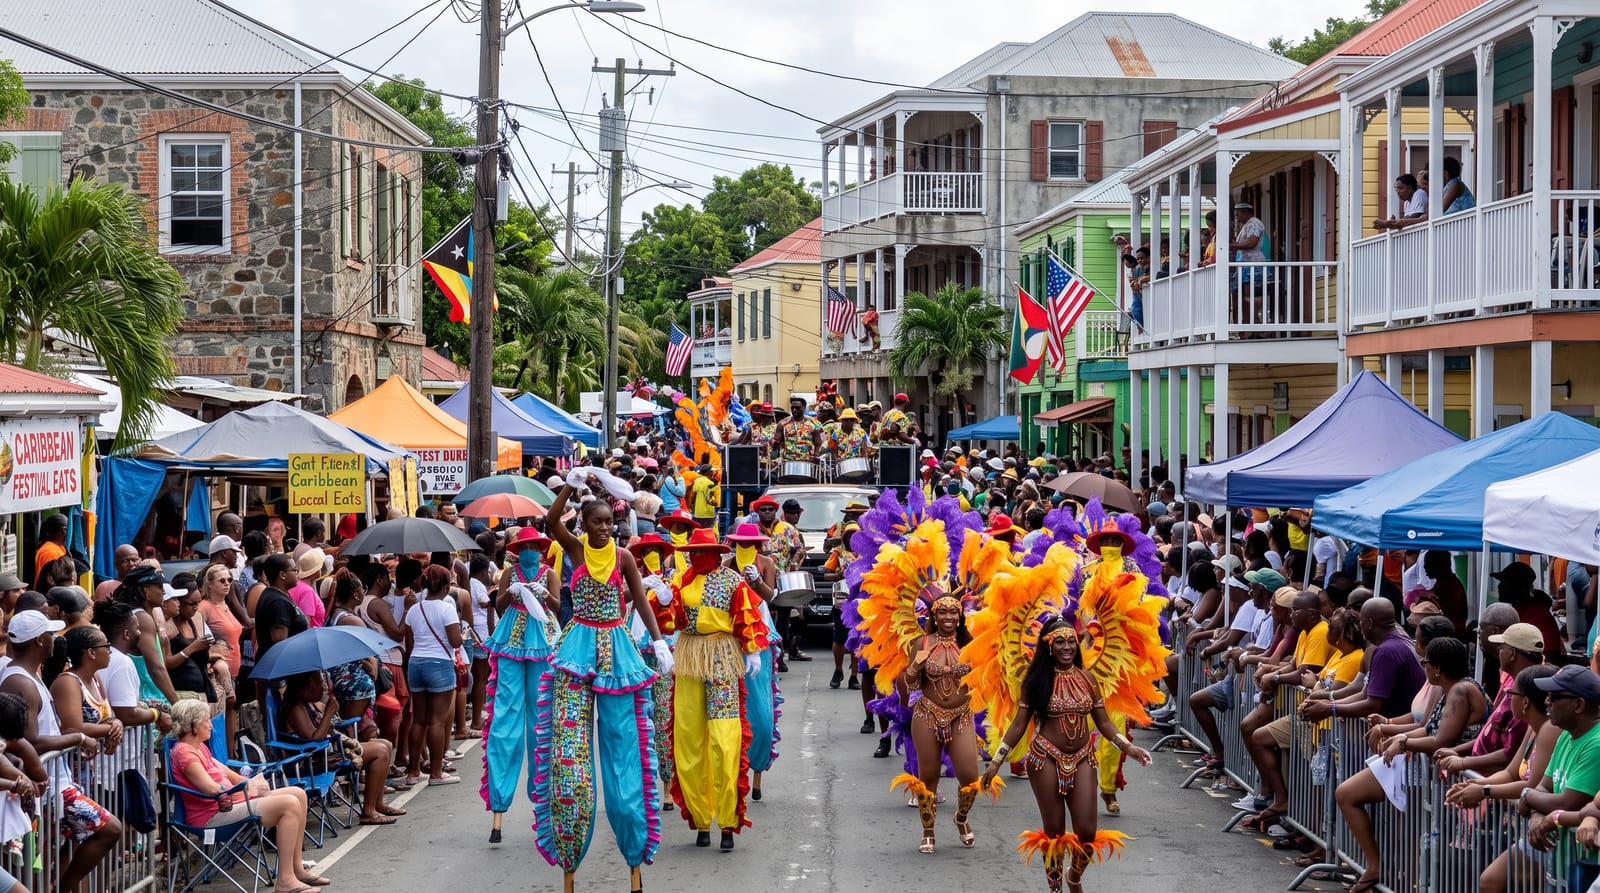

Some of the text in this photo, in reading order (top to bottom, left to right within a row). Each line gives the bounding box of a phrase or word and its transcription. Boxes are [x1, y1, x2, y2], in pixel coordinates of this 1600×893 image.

[15, 431, 74, 465] CARIBBEAN
[12, 467, 77, 500] FESTIVAL EATS
[290, 471, 358, 488] Caribbean
[333, 490, 362, 506] Eats
